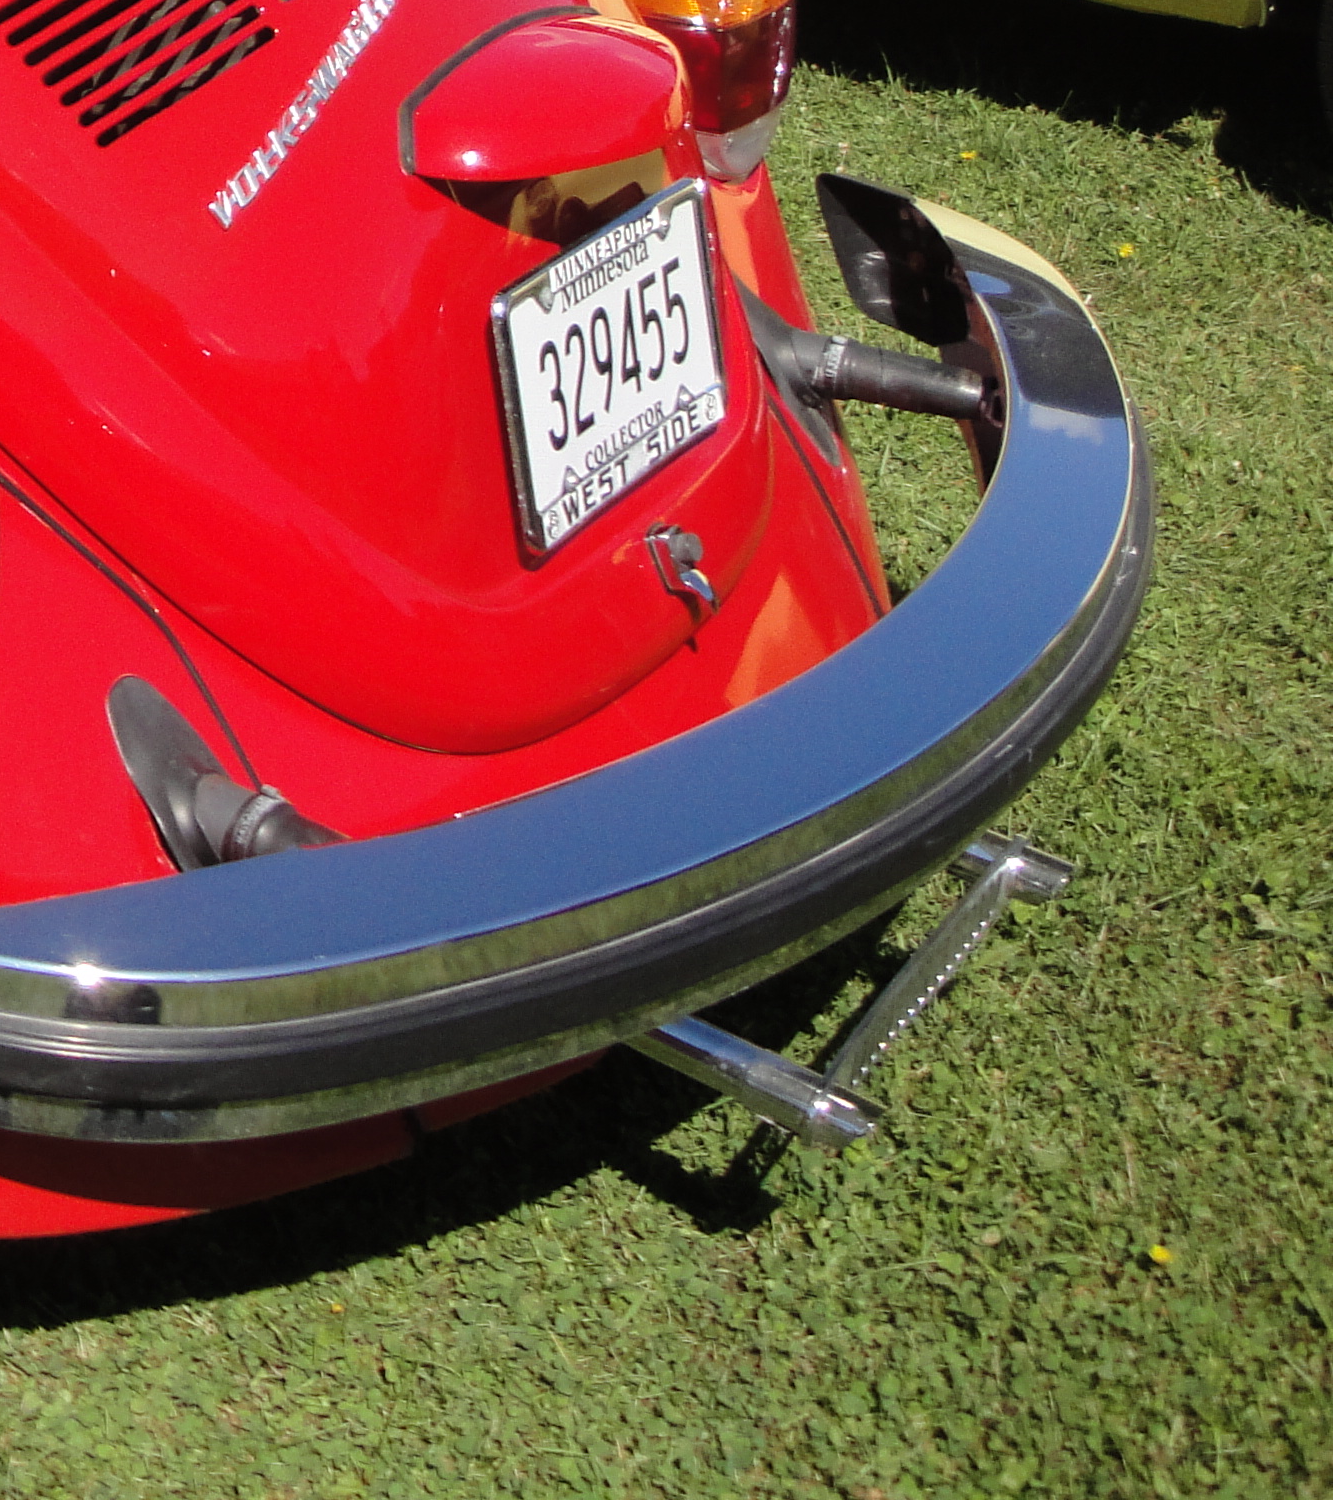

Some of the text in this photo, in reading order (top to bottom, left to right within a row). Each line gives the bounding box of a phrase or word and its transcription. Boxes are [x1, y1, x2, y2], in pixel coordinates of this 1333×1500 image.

[554, 214, 654, 286] MINNEAPOLIS
[560, 239, 649, 313] Minnesota
[538, 256, 690, 452] 329455
[562, 403, 701, 525] WEST SIDE
[585, 401, 666, 471] COLLECTOR
